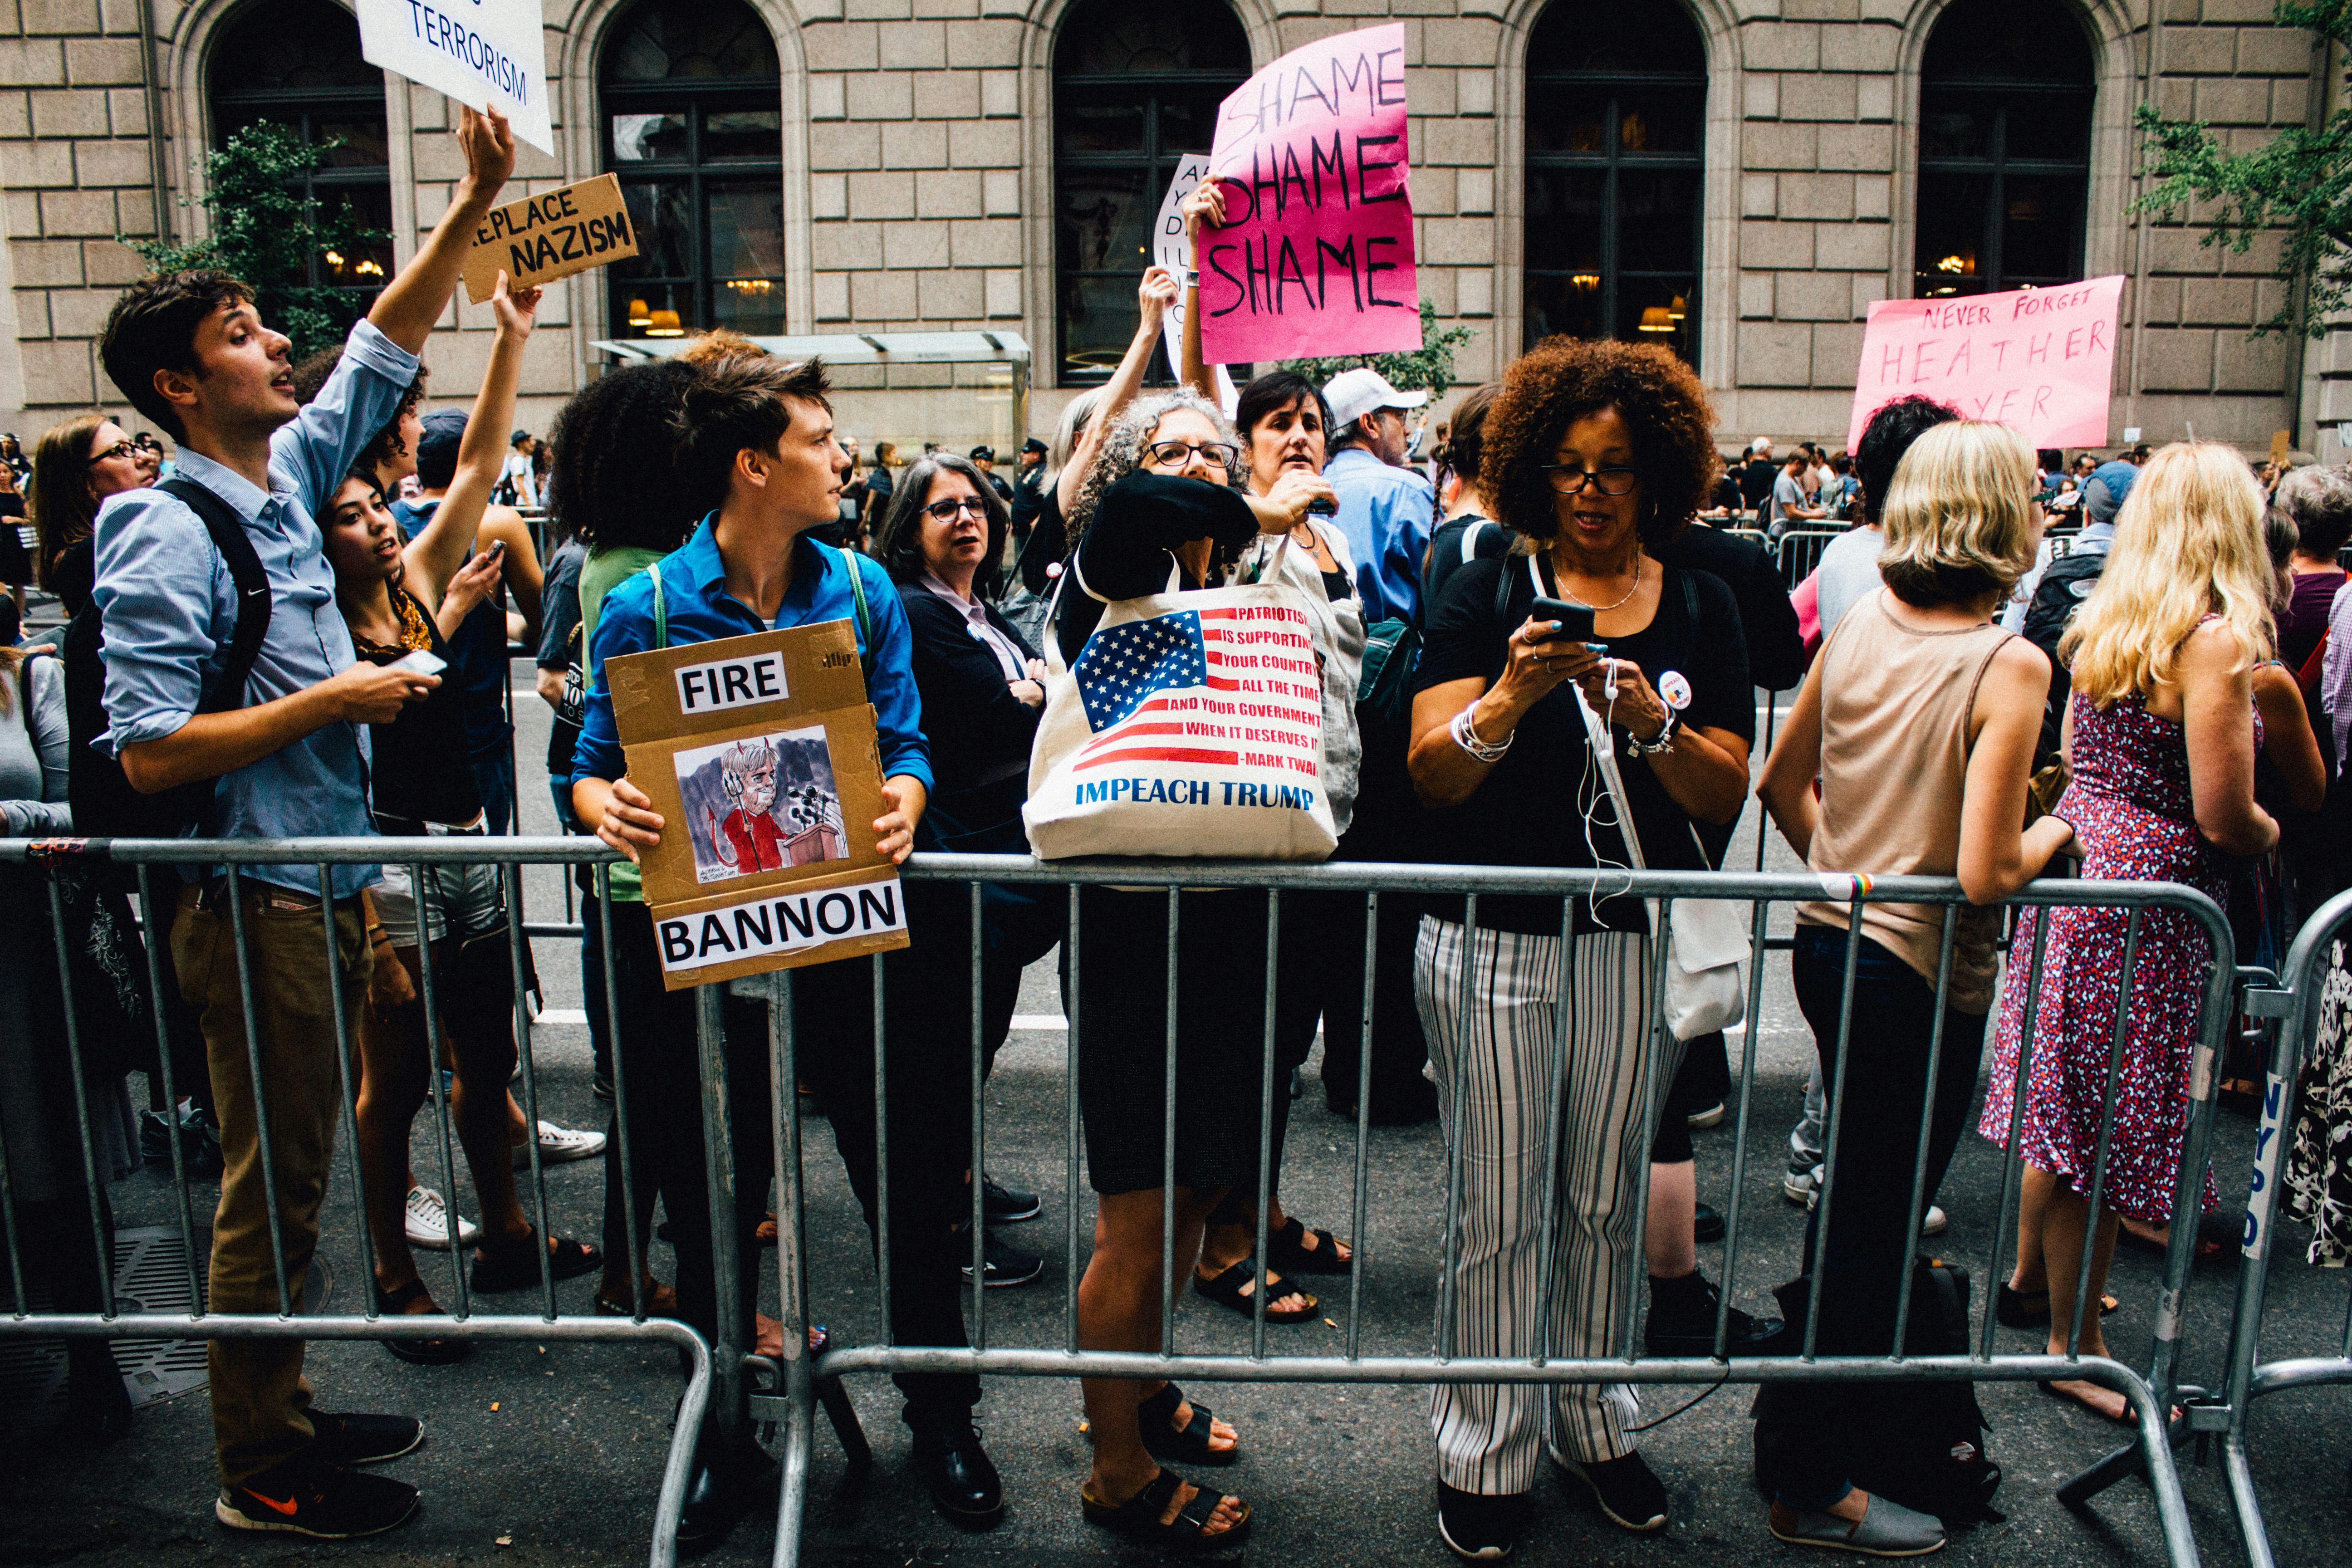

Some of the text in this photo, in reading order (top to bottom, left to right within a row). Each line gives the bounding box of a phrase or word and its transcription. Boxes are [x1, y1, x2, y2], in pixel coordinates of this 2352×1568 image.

[407, 0, 526, 106] TERRORISM
[1219, 48, 1406, 155] SHAME
[1205, 129, 1405, 229] SHAME
[472, 189, 578, 247] EPLACE
[510, 211, 631, 277] NAZISM
[1208, 230, 1404, 317] SHAME
[1923, 287, 2097, 330] NEVER FORGET
[1881, 319, 2107, 384] HEATHER
[1945, 385, 2053, 423] YER
[1223, 629, 1234, 643] IS
[681, 659, 780, 709] FIRE
[1224, 654, 1317, 677] YOUR COUNTRY
[1170, 697, 1321, 728] AND YOUR GOVERNMENT
[1242, 679, 1319, 703] ALL THE TIME
[578, 710, 584, 721] S
[1186, 722, 1225, 738] WHEN
[1230, 726, 1242, 739] IT
[1245, 728, 1308, 748] DESERVES
[1240, 752, 1318, 777] -MARK TWAI
[1076, 779, 1313, 811] IMPEACH TRUMP
[660, 885, 897, 964] BANNON
